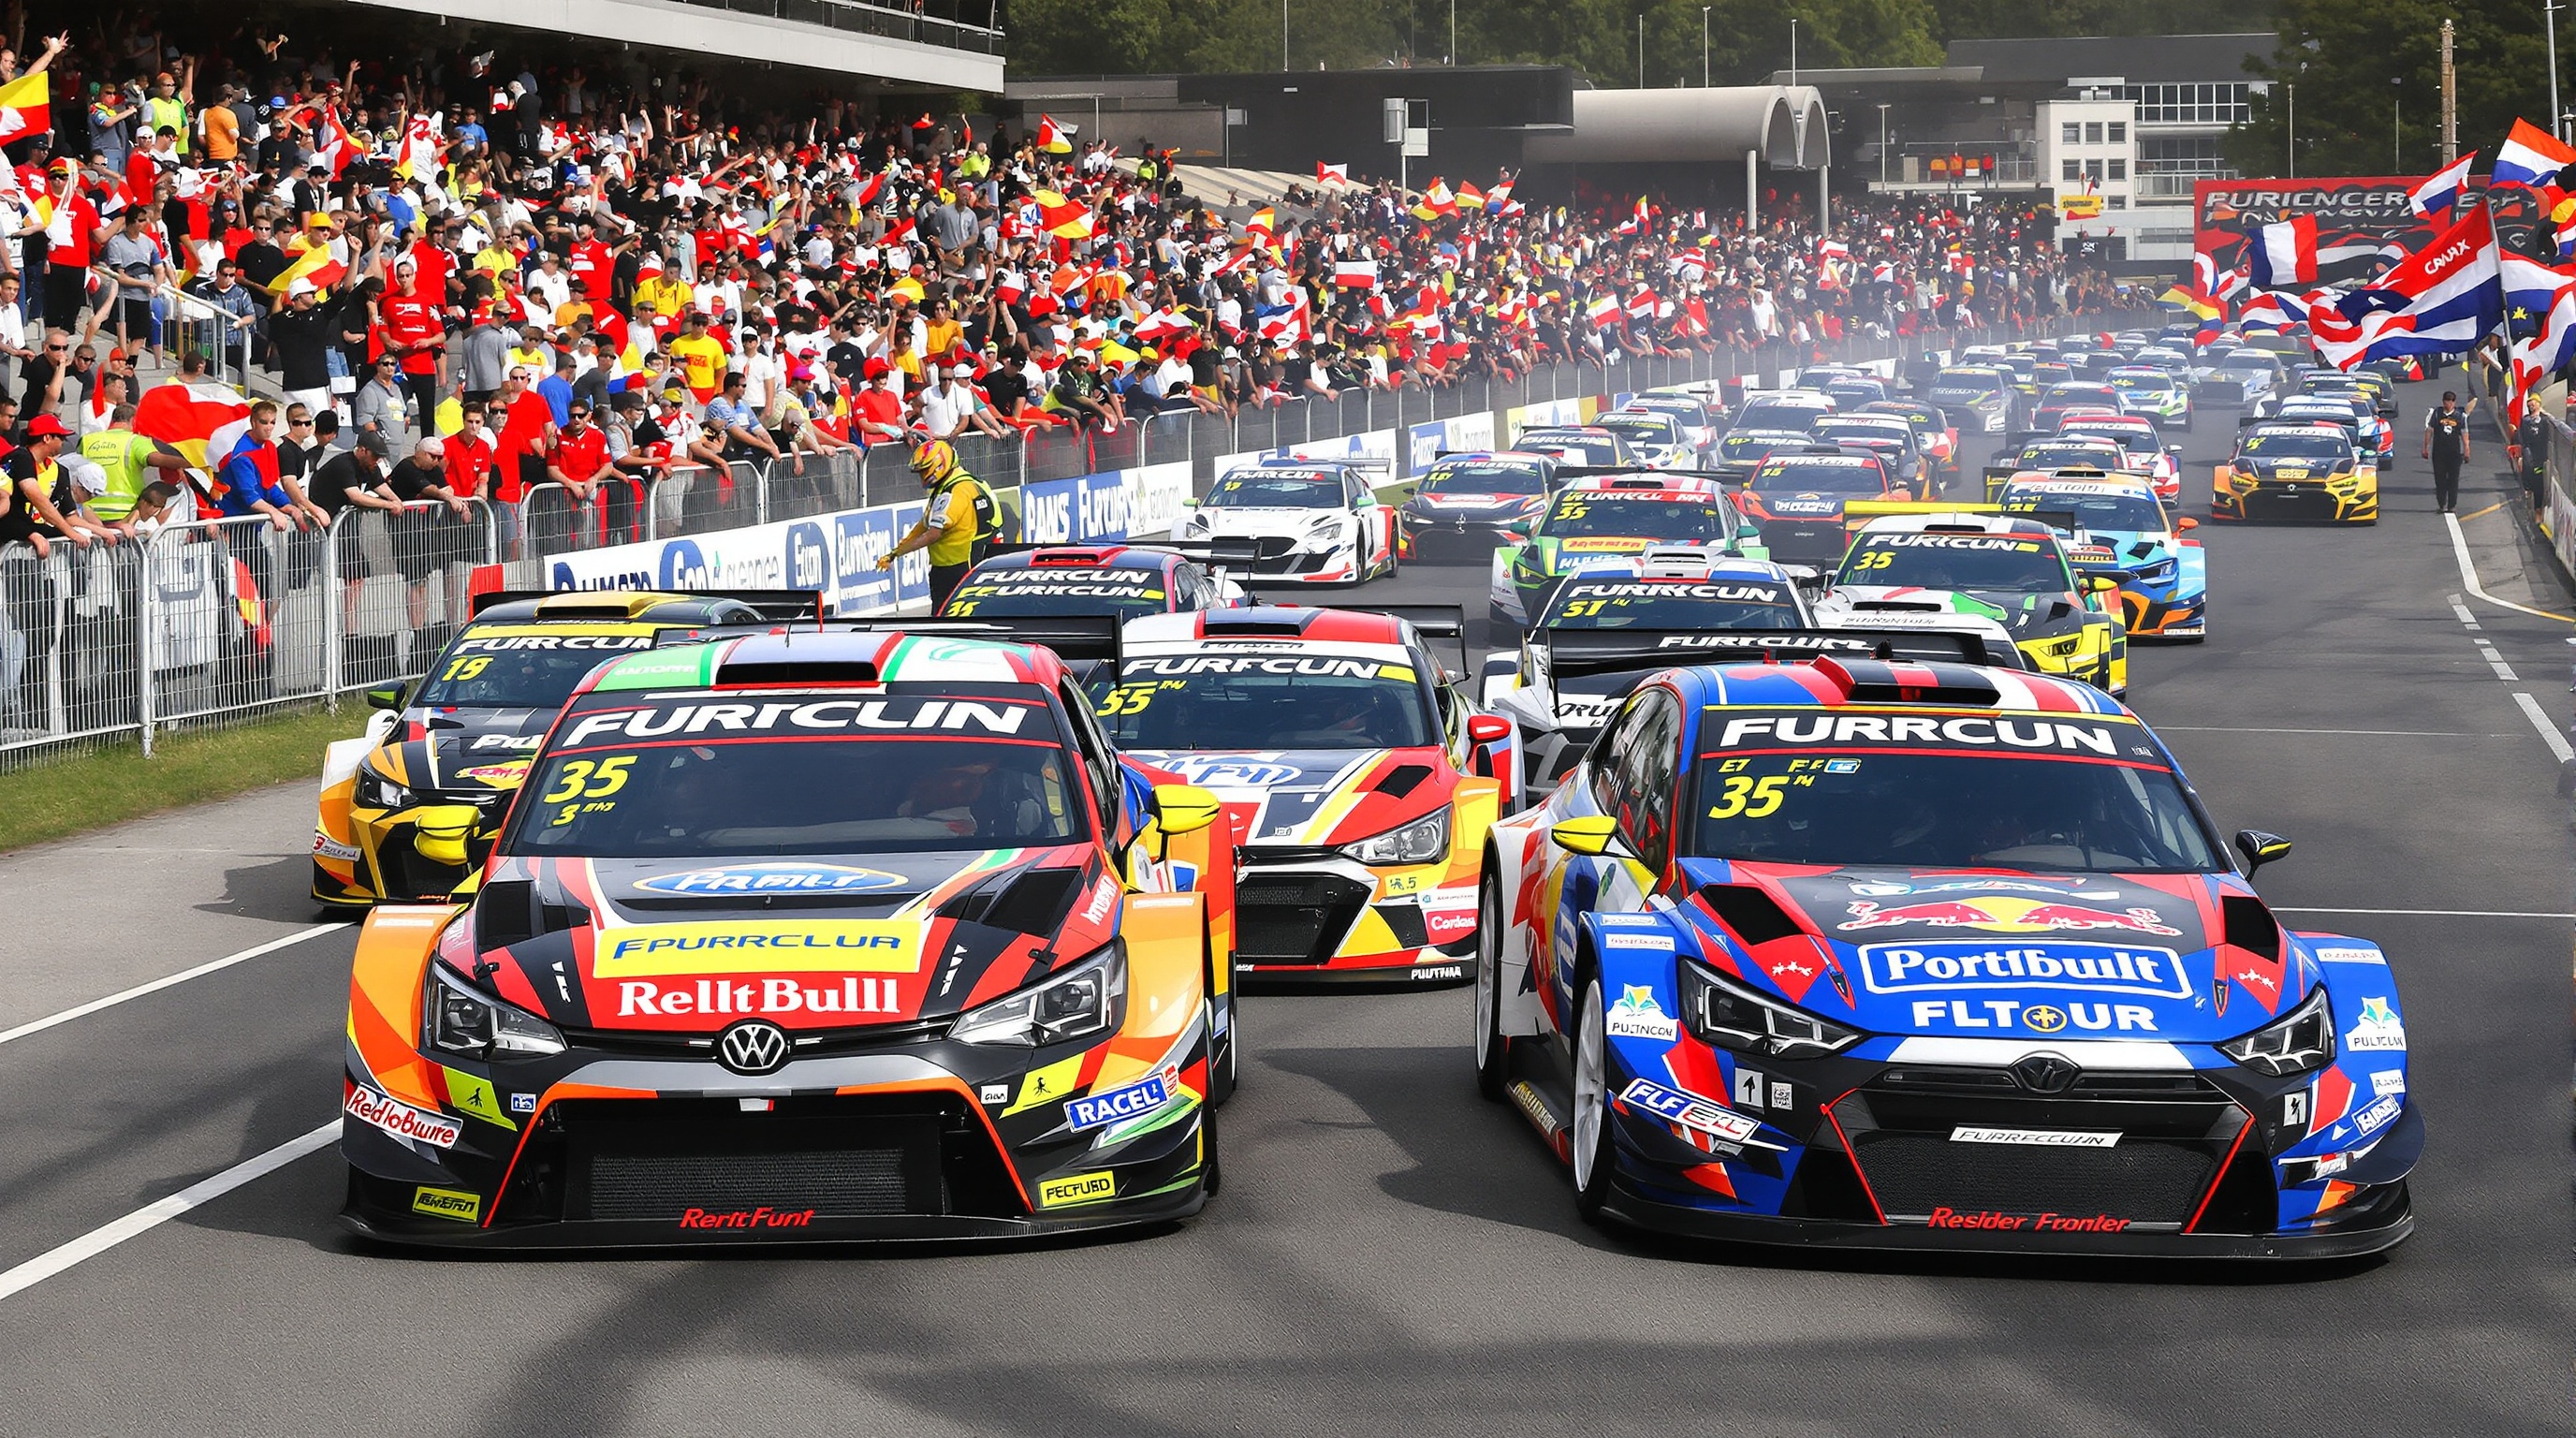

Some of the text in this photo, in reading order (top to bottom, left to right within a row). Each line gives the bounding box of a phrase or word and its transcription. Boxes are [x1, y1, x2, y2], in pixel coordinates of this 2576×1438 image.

[1854, 552, 1896, 570] 35
[1719, 716, 2119, 756] FURRCUN
[544, 756, 638, 803] 35
[1708, 776, 1790, 819] 35
